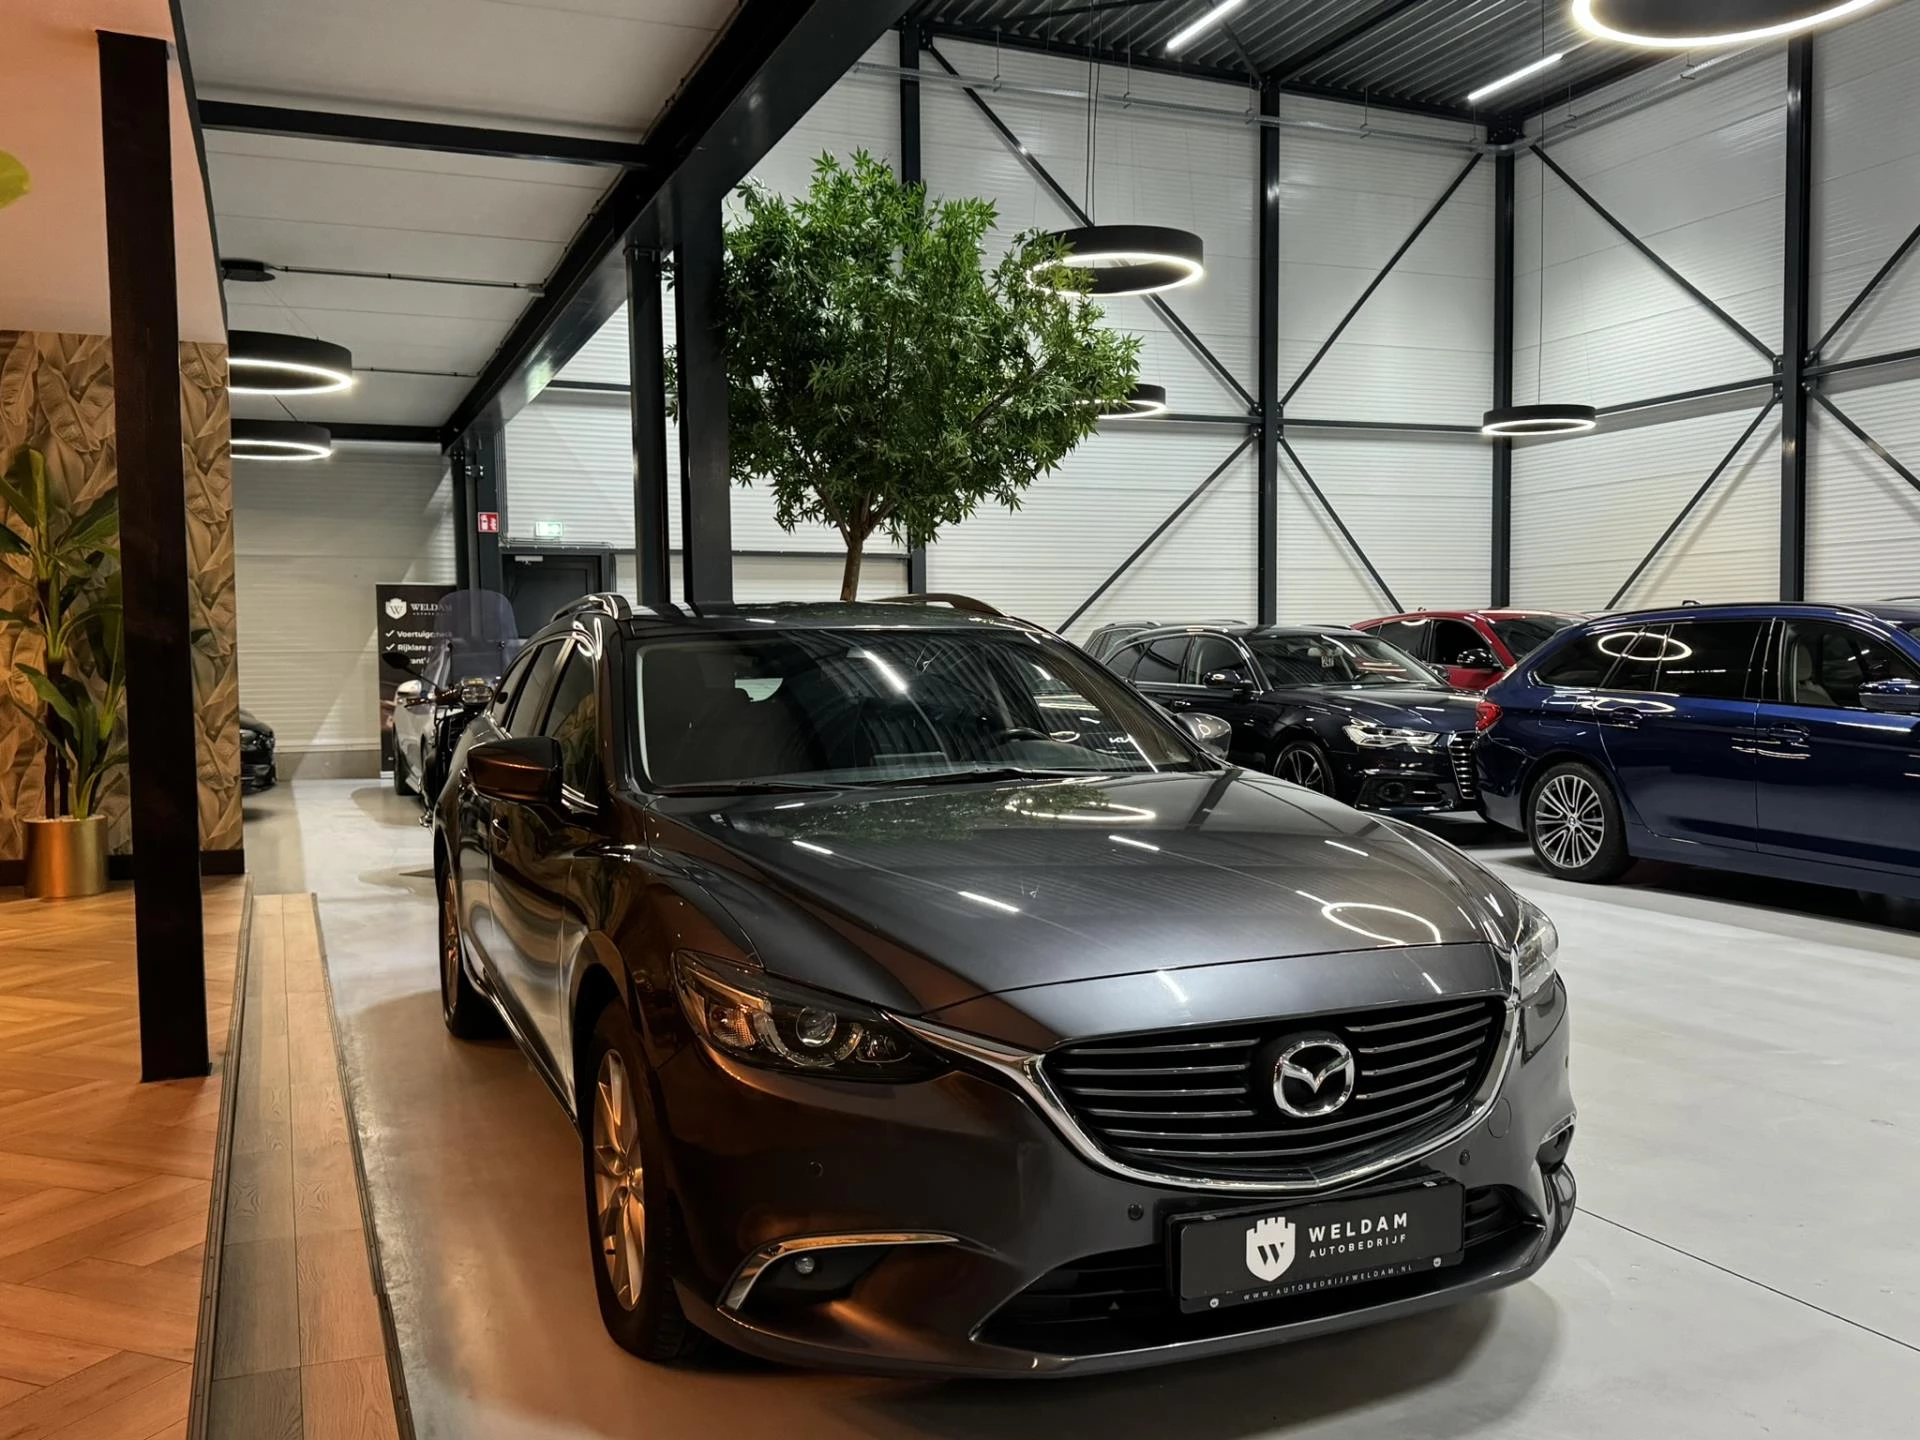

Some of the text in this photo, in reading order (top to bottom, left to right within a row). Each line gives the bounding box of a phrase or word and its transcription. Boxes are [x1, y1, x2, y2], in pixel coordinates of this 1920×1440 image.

[1308, 1211, 1408, 1243] WELDAM
[1308, 1233, 1407, 1259] AUTOBEDRIJF
[1242, 1263, 1414, 1301] WWW.AUTOBEDRIJFWELDAM.NL
